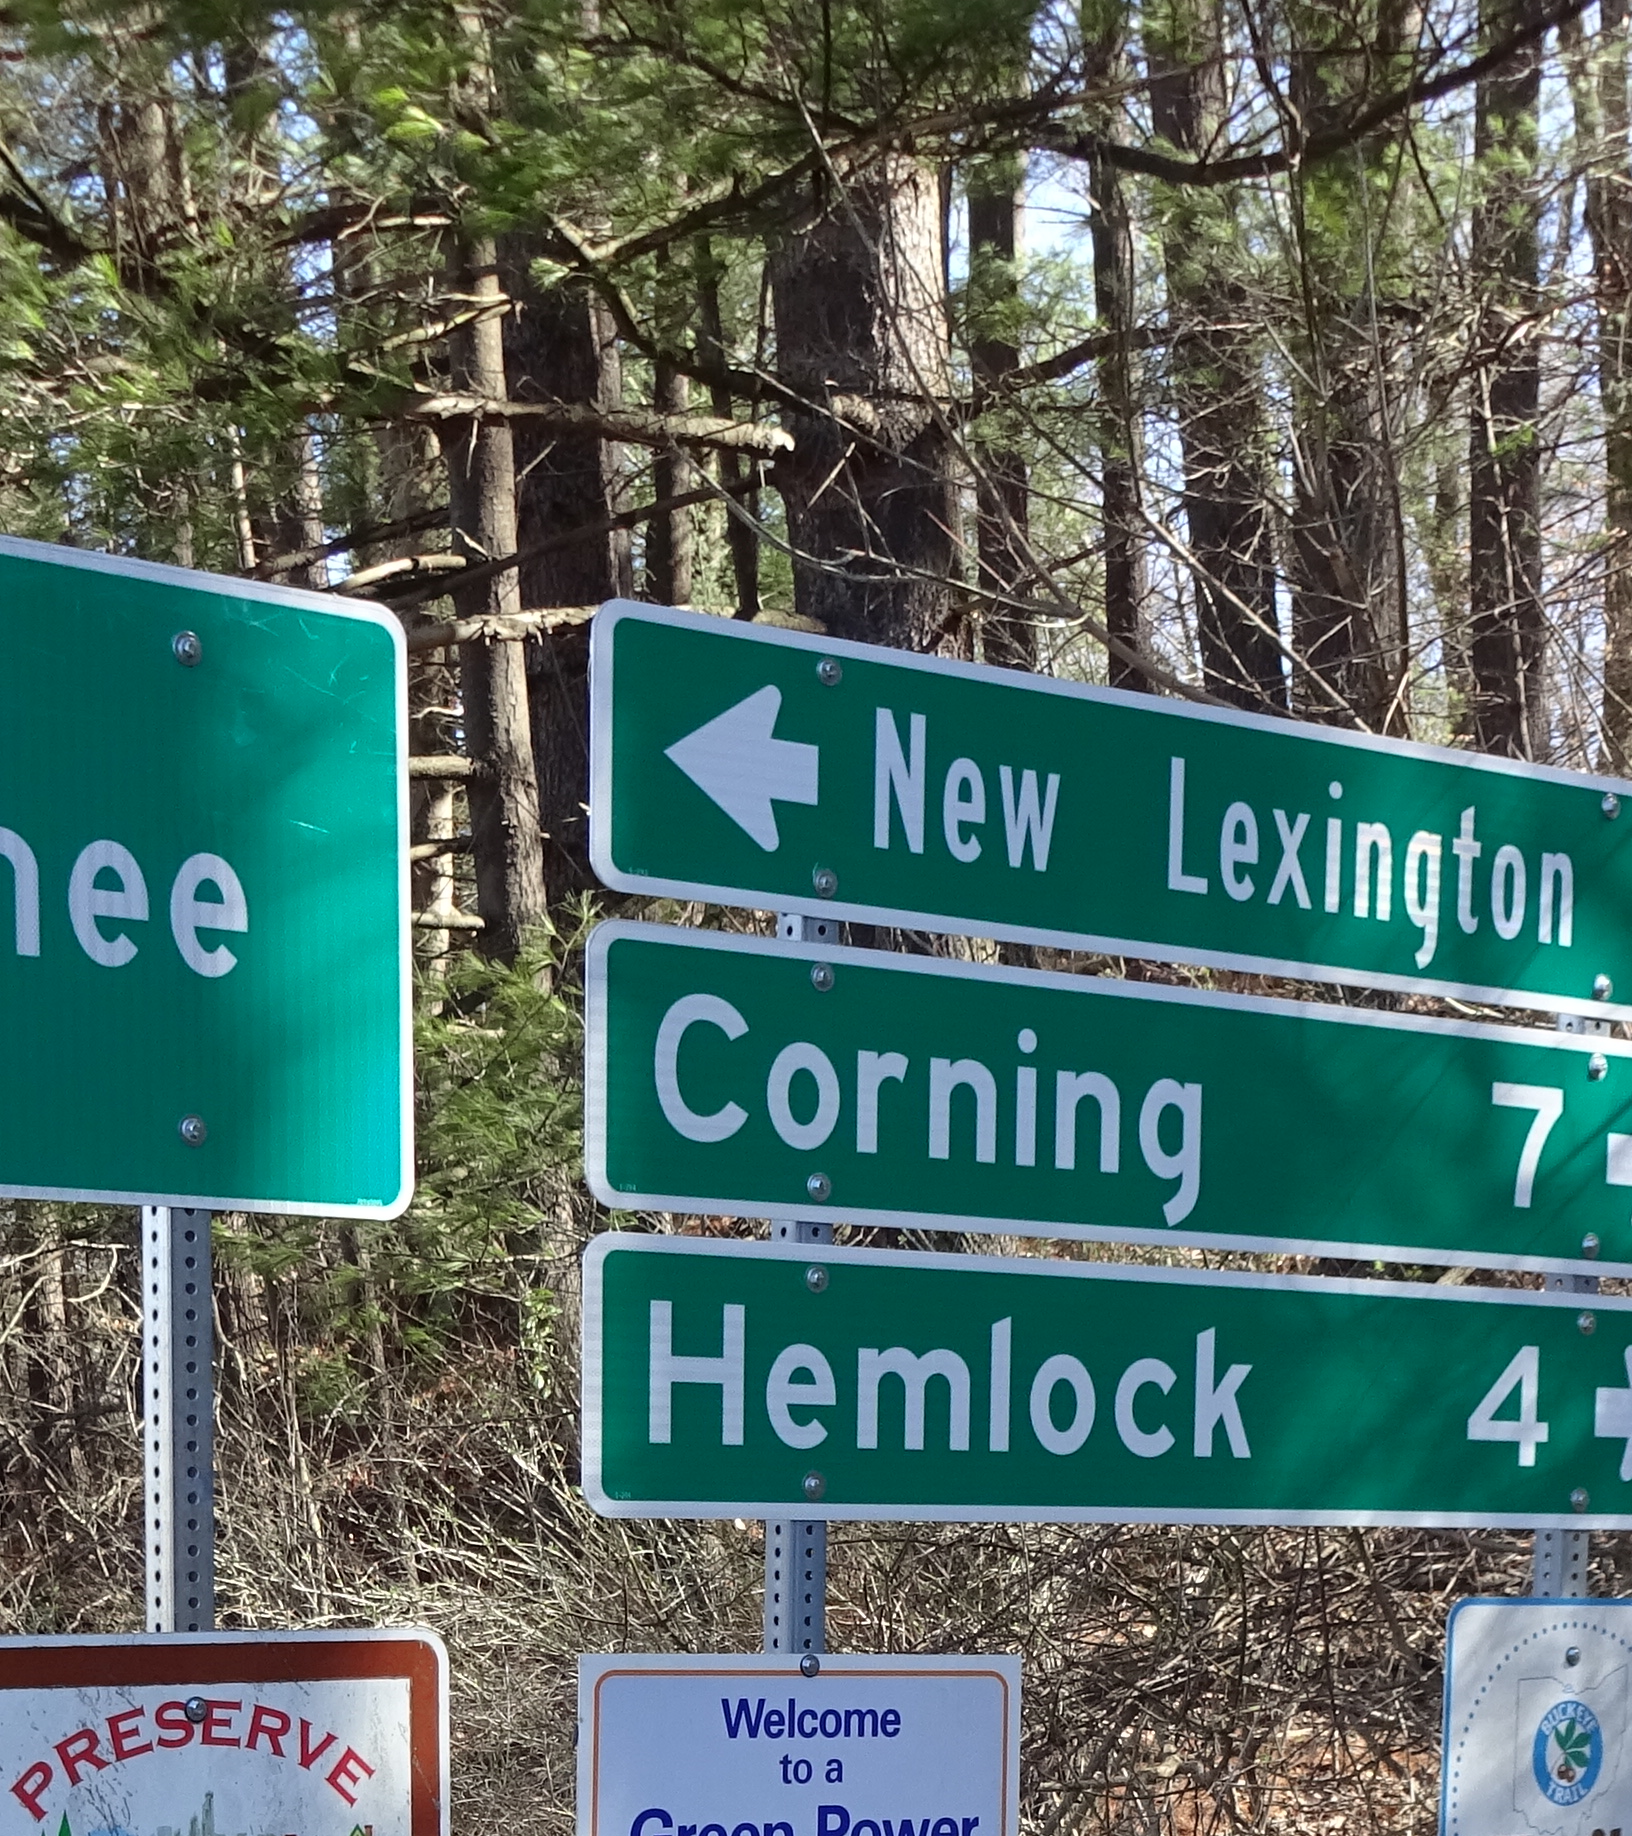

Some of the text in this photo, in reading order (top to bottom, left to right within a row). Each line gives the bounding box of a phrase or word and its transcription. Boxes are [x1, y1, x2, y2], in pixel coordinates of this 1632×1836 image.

[872, 707, 1060, 873] New
[1168, 755, 1574, 970] Lexington
[654, 992, 1565, 1227] Corning 7
[647, 1299, 1550, 1468] Hemlock 4
[8, 1698, 377, 1823] PRESERVE
[722, 1697, 901, 1740] Welcome
[1540, 1701, 1600, 1736] BUCKEYE
[779, 1752, 843, 1784] to a
[1546, 1781, 1588, 1805] TRAIL
